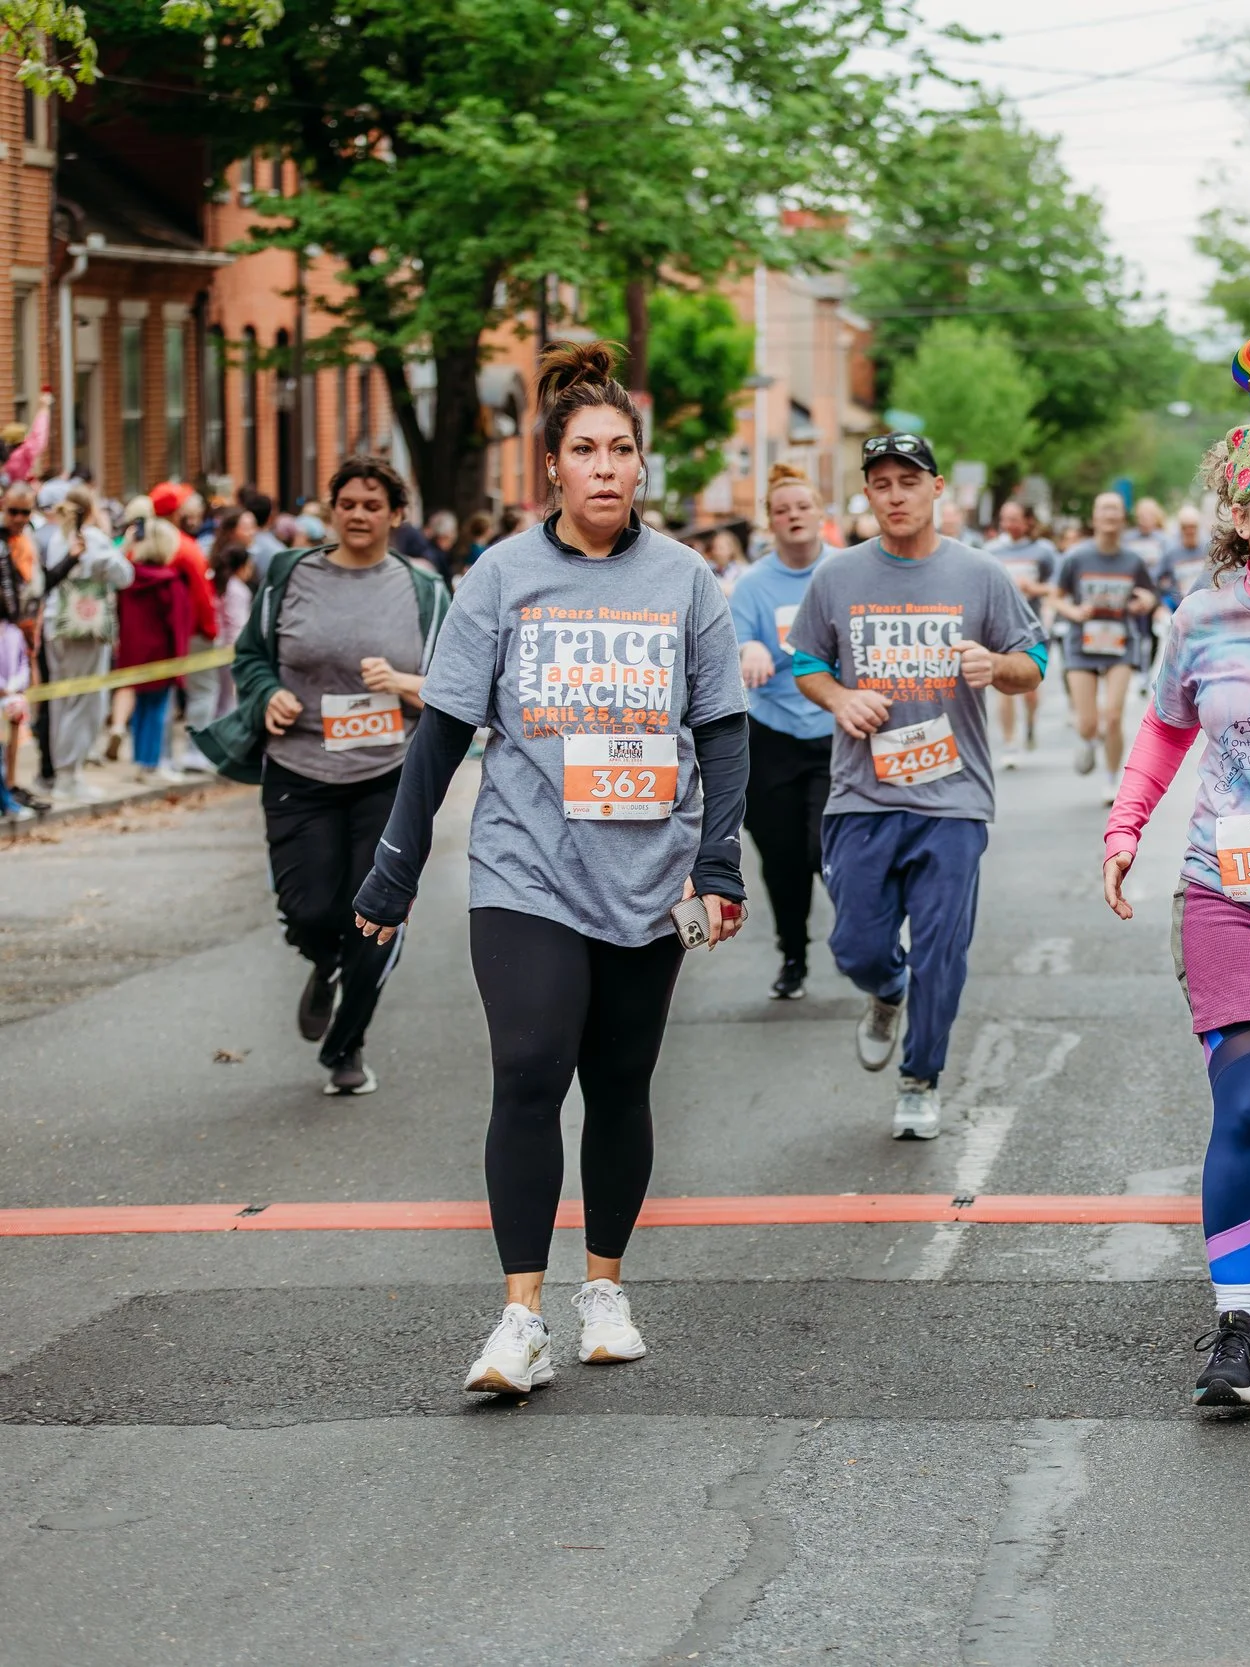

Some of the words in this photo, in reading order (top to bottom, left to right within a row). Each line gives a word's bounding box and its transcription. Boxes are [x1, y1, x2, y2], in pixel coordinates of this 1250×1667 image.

[520, 607, 543, 620] 28
[546, 607, 594, 620] Years
[599, 607, 677, 626] Running!
[867, 603, 902, 614] Years
[849, 616, 869, 676] ywca
[865, 619, 963, 647] race
[541, 628, 678, 668] race
[519, 624, 541, 703] ywca
[547, 663, 669, 687] against
[869, 661, 960, 679] RACISM
[857, 677, 894, 689] APRIL
[541, 683, 671, 711] RACISM
[331, 712, 394, 738] 6001
[522, 706, 579, 722] APRIL
[583, 706, 616, 724] 25,
[621, 708, 669, 726] 2026
[884, 742, 951, 776] 2462
[590, 769, 657, 798] 362
